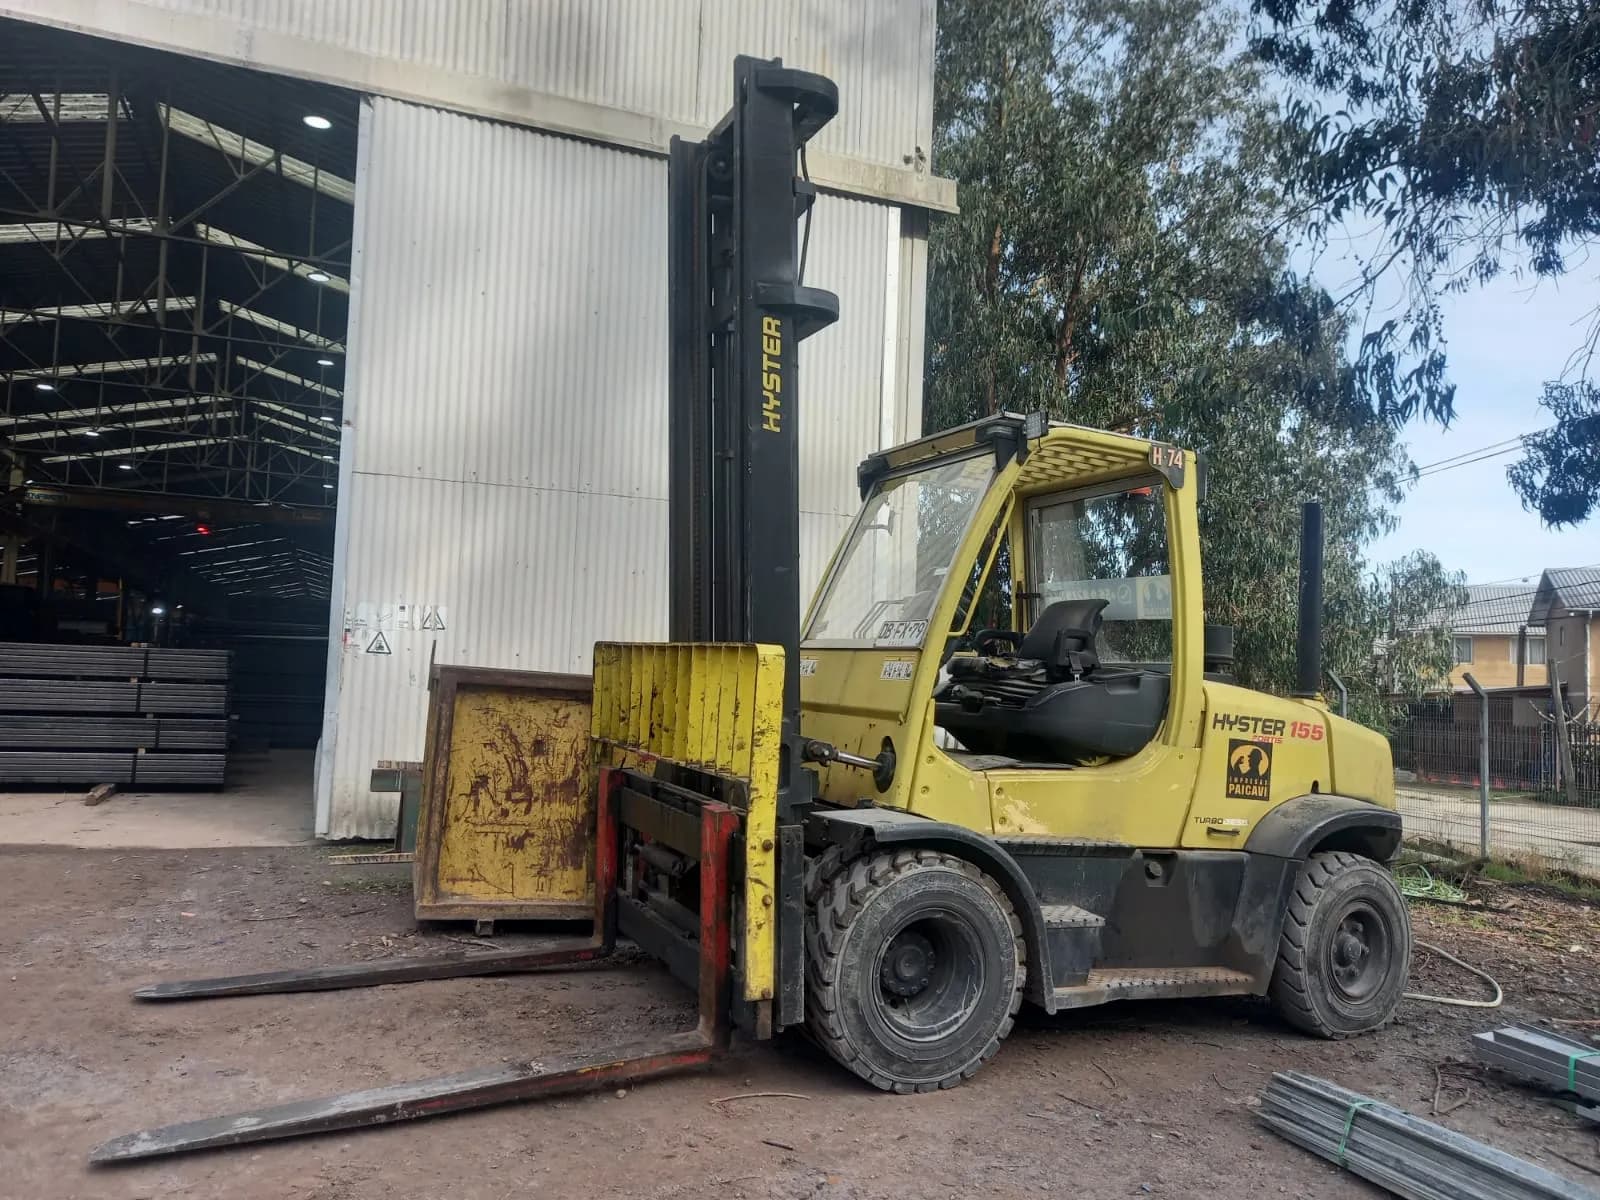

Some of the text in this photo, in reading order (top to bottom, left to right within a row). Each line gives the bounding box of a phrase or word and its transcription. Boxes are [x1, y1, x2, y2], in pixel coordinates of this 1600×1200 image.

[762, 316, 781, 433] HYSTER
[1212, 712, 1324, 741] HYSTER 155
[1193, 816, 1223, 825] TURBO
